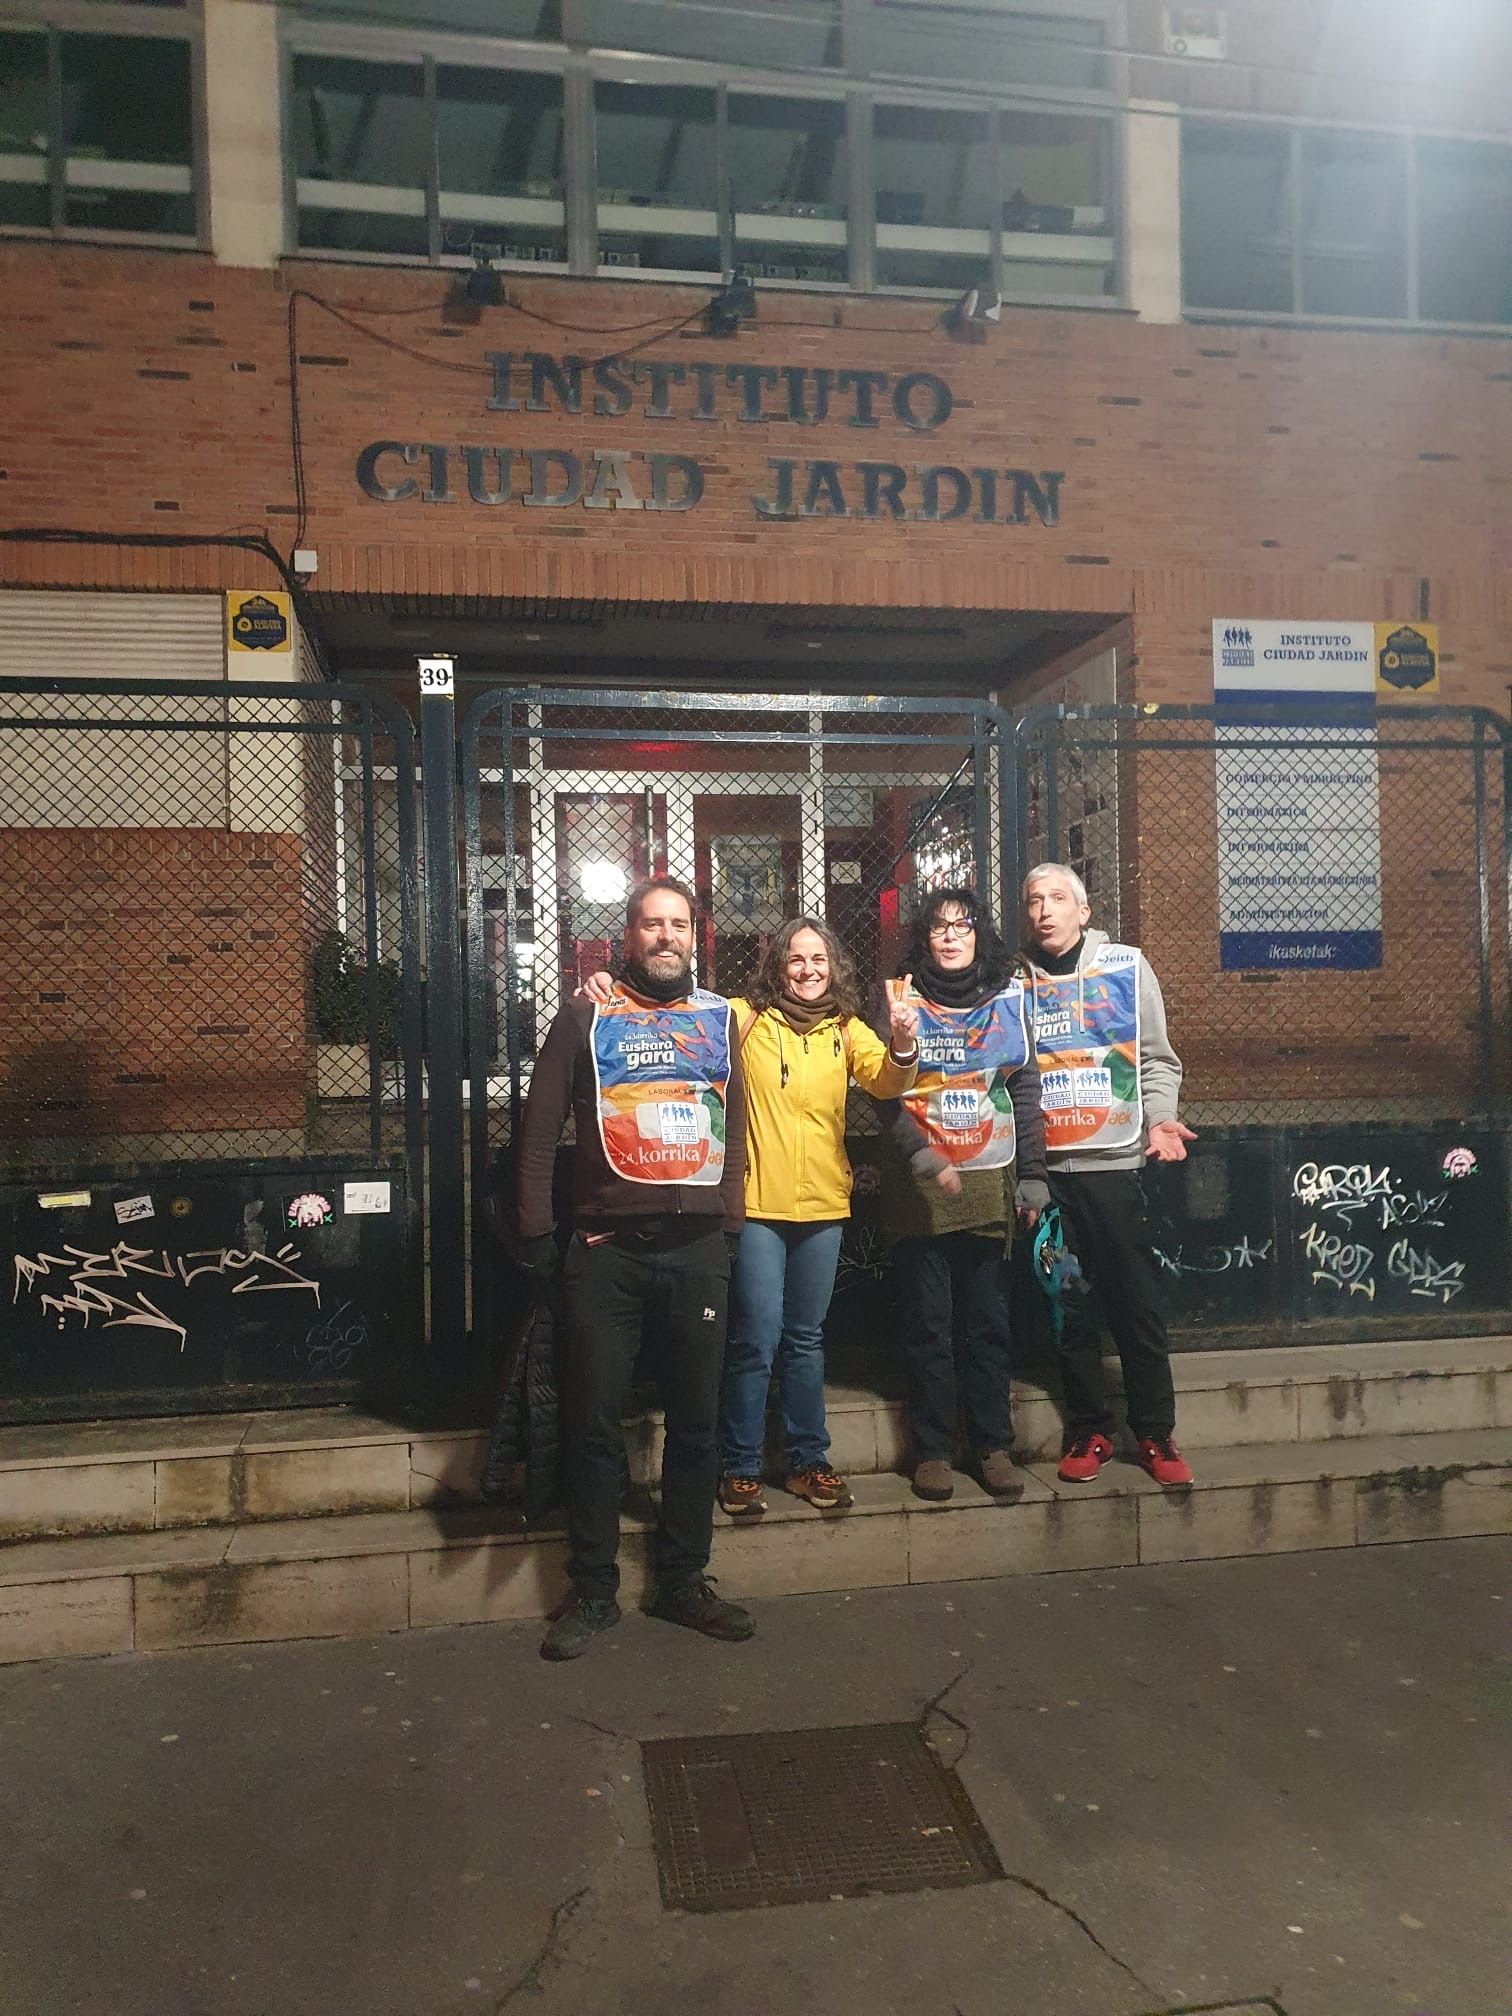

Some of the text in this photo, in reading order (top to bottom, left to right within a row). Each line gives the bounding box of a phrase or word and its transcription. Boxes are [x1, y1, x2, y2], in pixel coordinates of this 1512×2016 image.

[483, 350, 953, 432] INSTITUTO
[355, 439, 1067, 528] CIUDAD JARDIN
[1280, 634, 1351, 646] INSTITUTO
[1263, 649, 1368, 662] CIUDAD JARDIN
[422, 668, 449, 686] 39
[1269, 943, 1337, 959] ikasketak
[618, 1040, 673, 1053] Euskara
[920, 1046, 966, 1063] gara
[626, 1050, 675, 1071] gara
[927, 1129, 983, 1145] korrika
